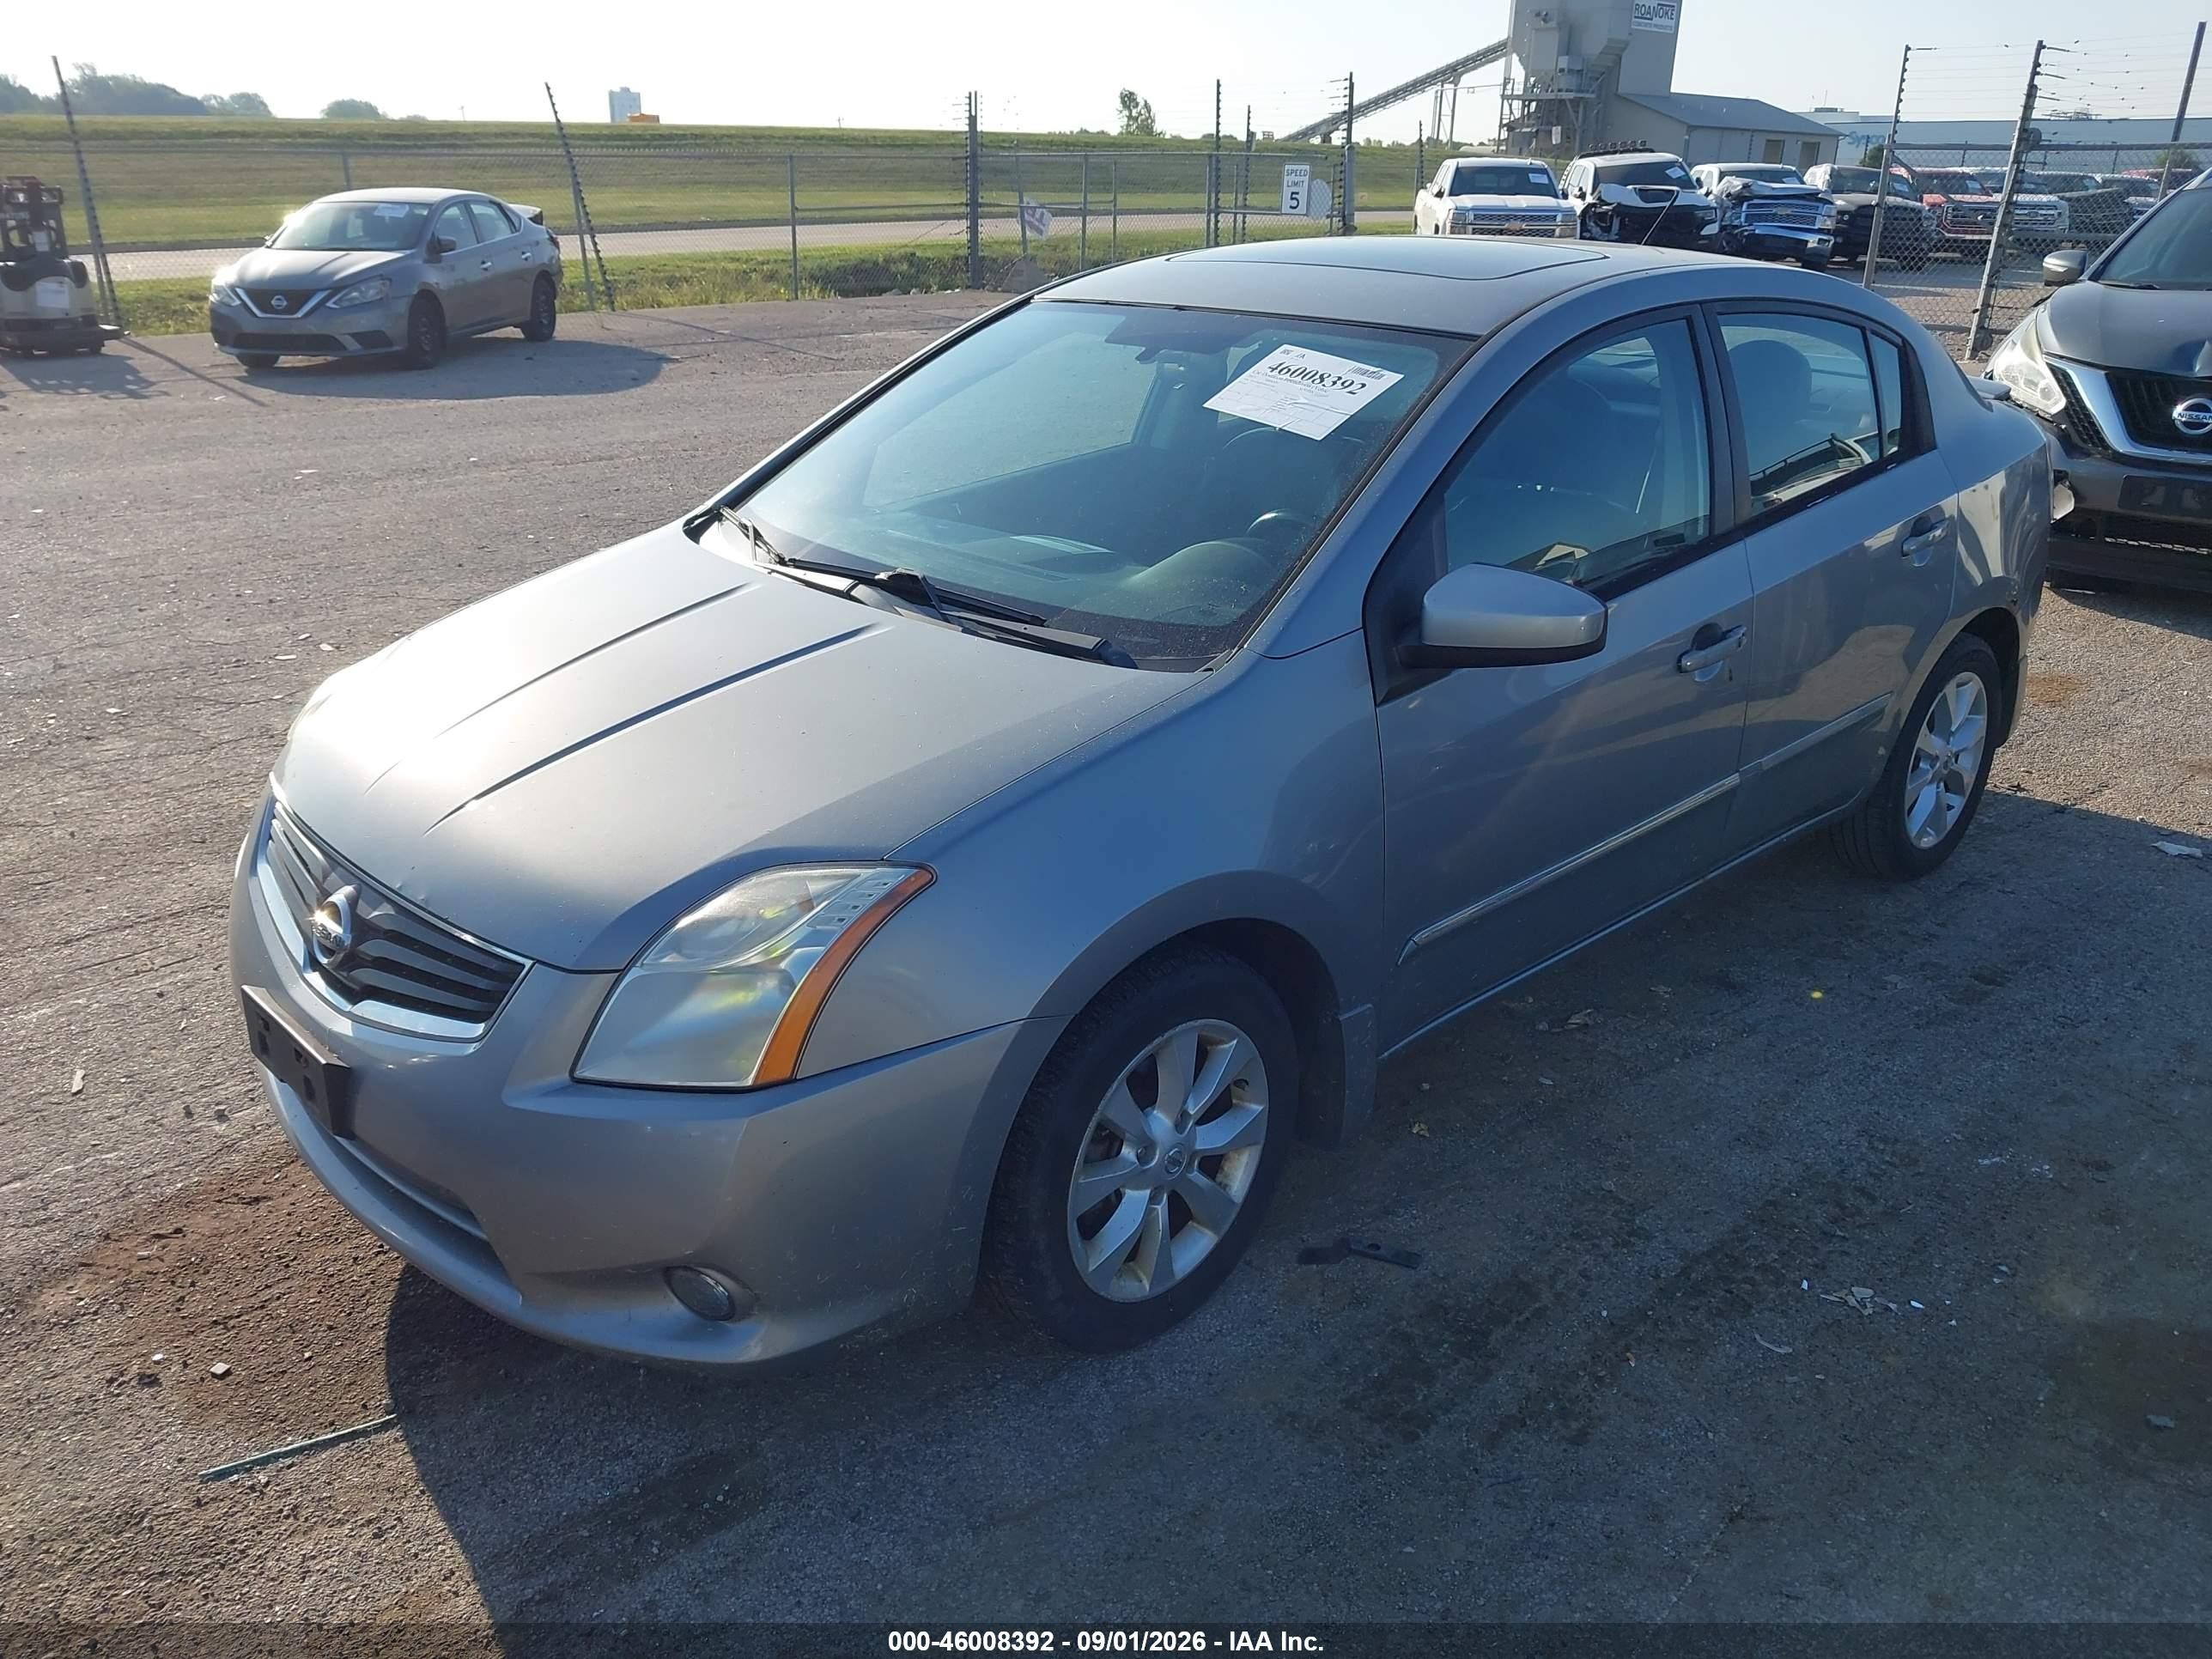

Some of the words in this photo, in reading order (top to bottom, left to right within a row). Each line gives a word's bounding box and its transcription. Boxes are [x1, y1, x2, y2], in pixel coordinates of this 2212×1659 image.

[1634, 3, 1675, 21] ROANOKE
[1285, 168, 1308, 177] SPEED
[1289, 191, 1300, 210] 5
[1268, 361, 1367, 395] 46008392
